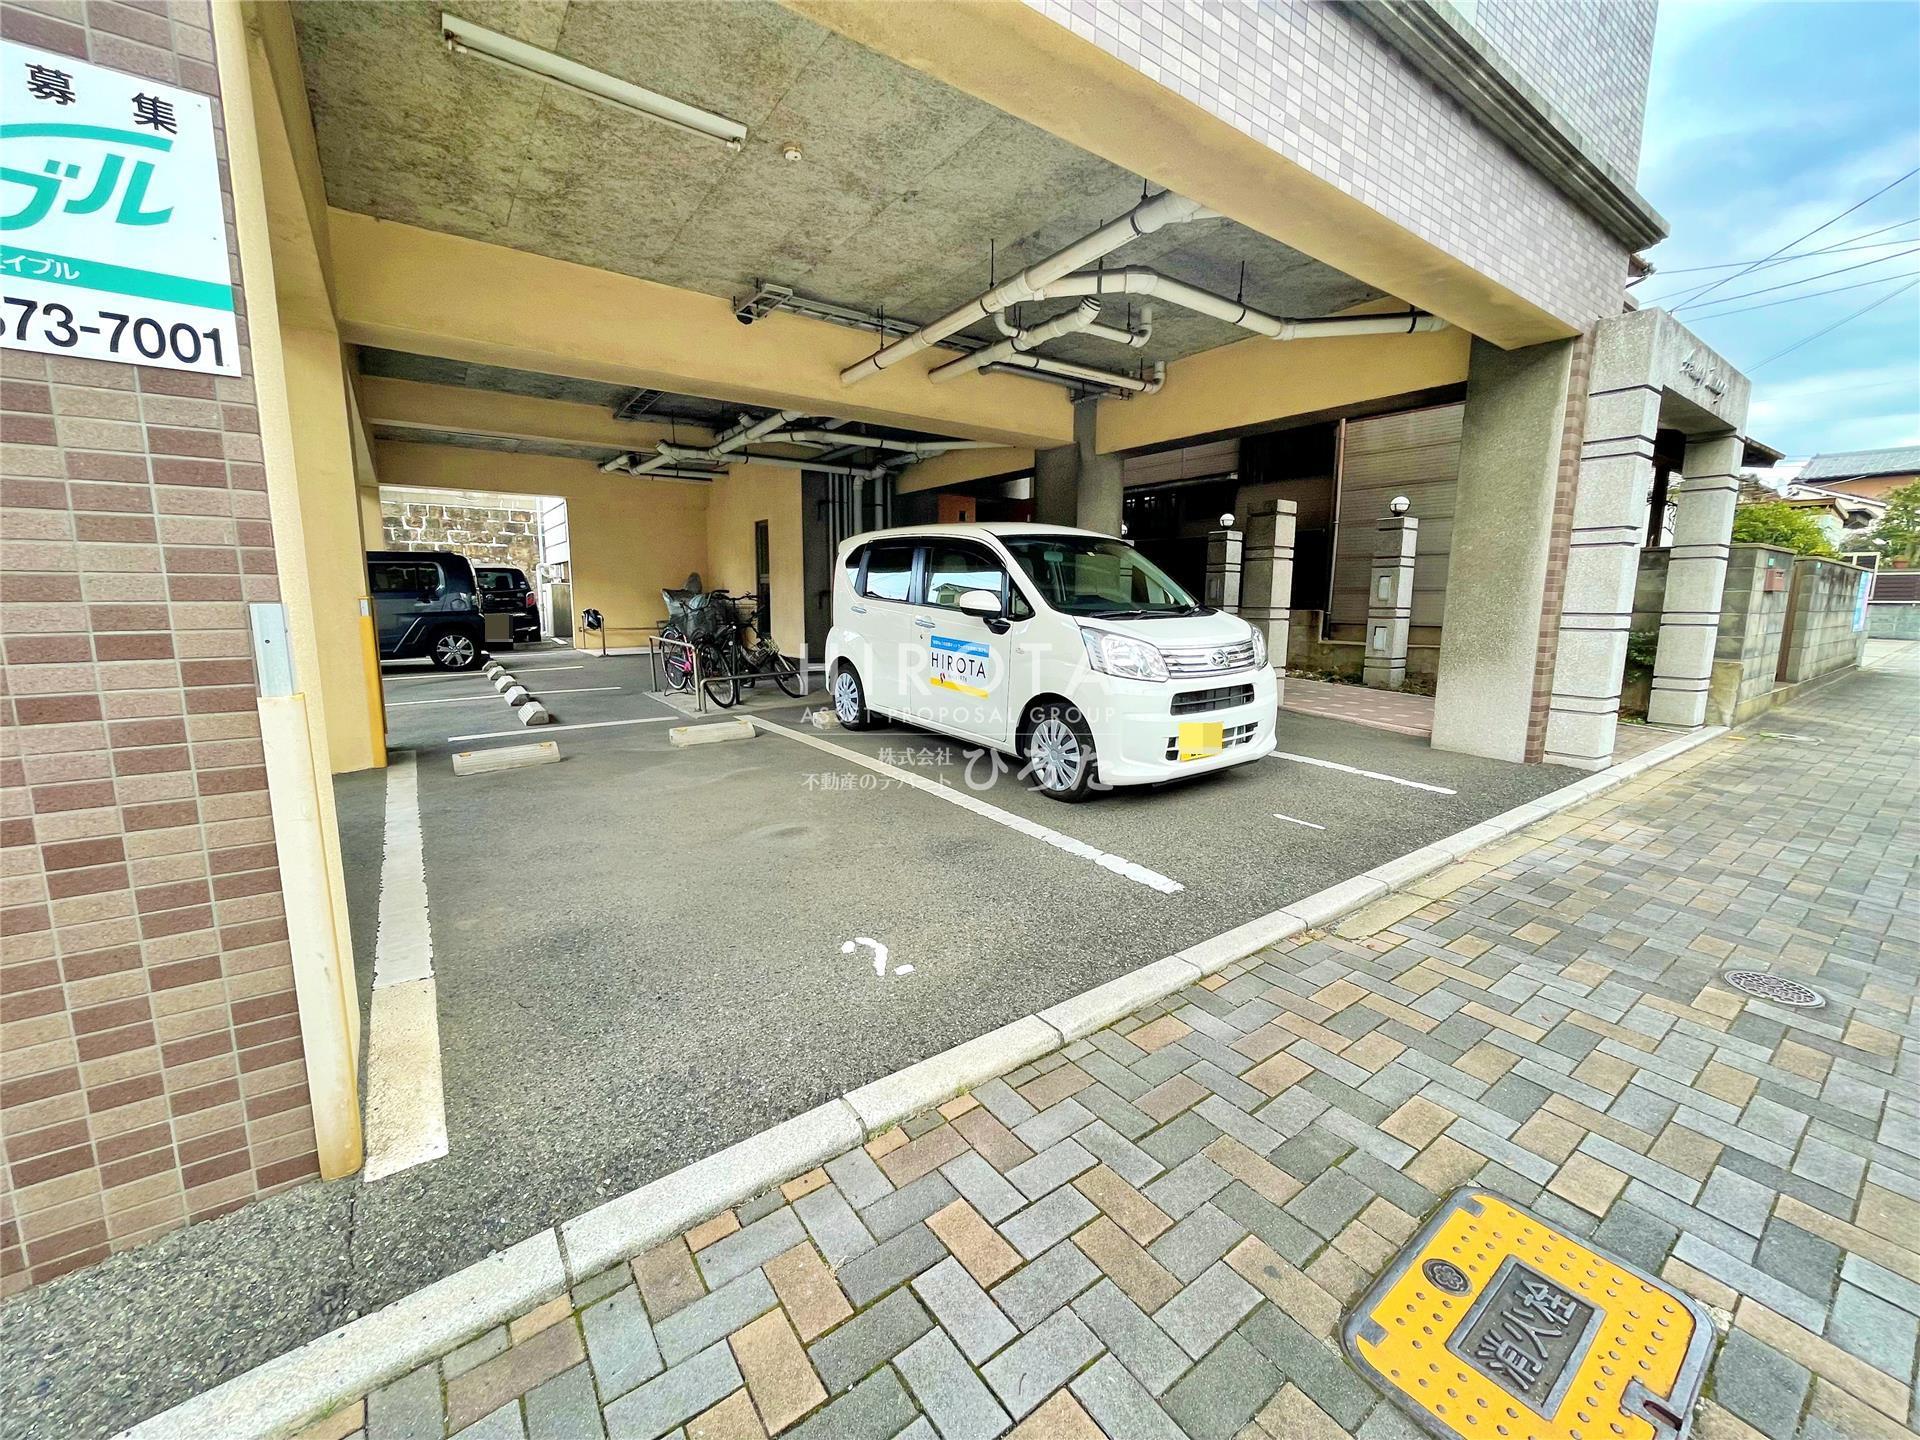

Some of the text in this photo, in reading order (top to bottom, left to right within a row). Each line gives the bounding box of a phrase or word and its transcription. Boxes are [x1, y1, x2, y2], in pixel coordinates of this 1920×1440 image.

[25, 63, 178, 134] 募集
[0, 296, 225, 367] 73-7001
[931, 652, 986, 679] HIROTA
[1474, 1280, 1577, 1391] 消火栓
